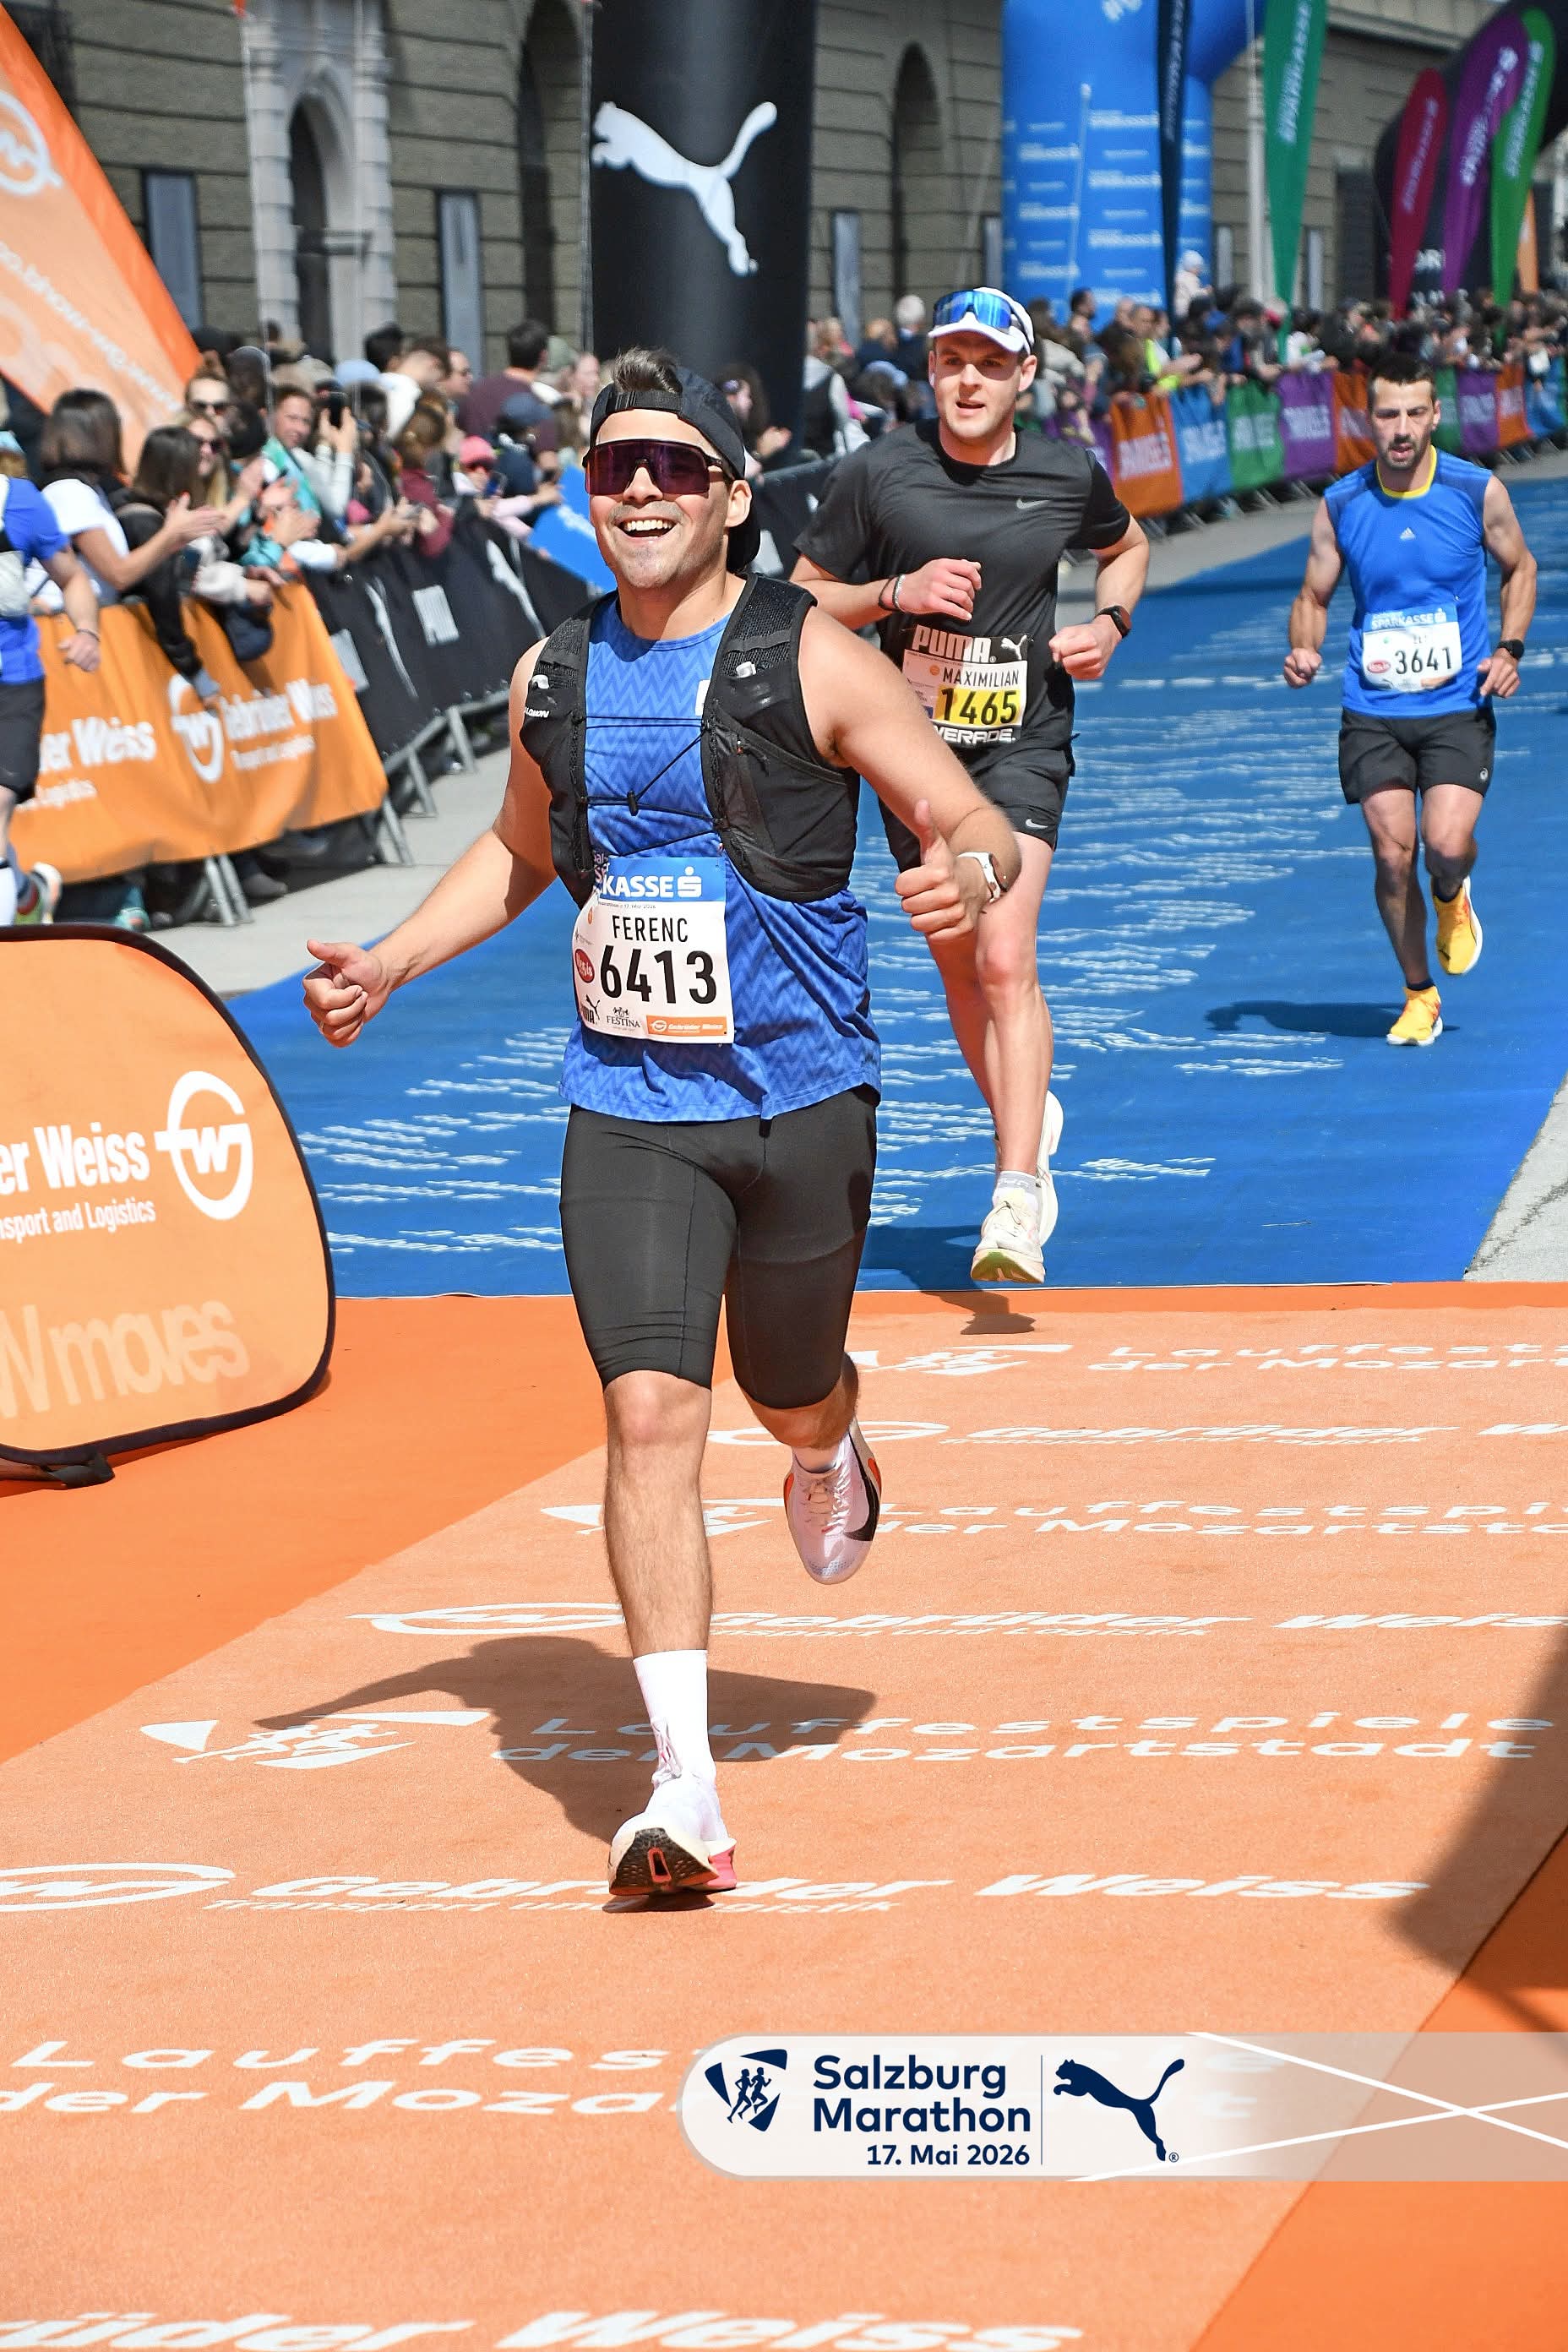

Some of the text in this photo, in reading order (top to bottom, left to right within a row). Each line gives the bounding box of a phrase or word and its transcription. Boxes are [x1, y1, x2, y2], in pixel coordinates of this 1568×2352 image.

[912, 625, 992, 663] PUMA
[1395, 646, 1452, 675] 3641
[943, 667, 1019, 688] MAXIMILIAN
[941, 688, 1017, 725] 1465
[612, 915, 689, 943] FERENC
[601, 945, 717, 1004] 6413
[607, 1016, 641, 1028] FESTINA
[33, 1121, 150, 1190] Weiss
[52, 1203, 84, 1233] and
[84, 1196, 157, 1234] Logistics
[1086, 1360, 1235, 1370] der
[966, 1424, 1461, 1438] Gebrüder
[722, 1739, 1538, 1763] Mozartstadt
[974, 1873, 1429, 1899] Weiss
[495, 2311, 1083, 2352] Weiss
